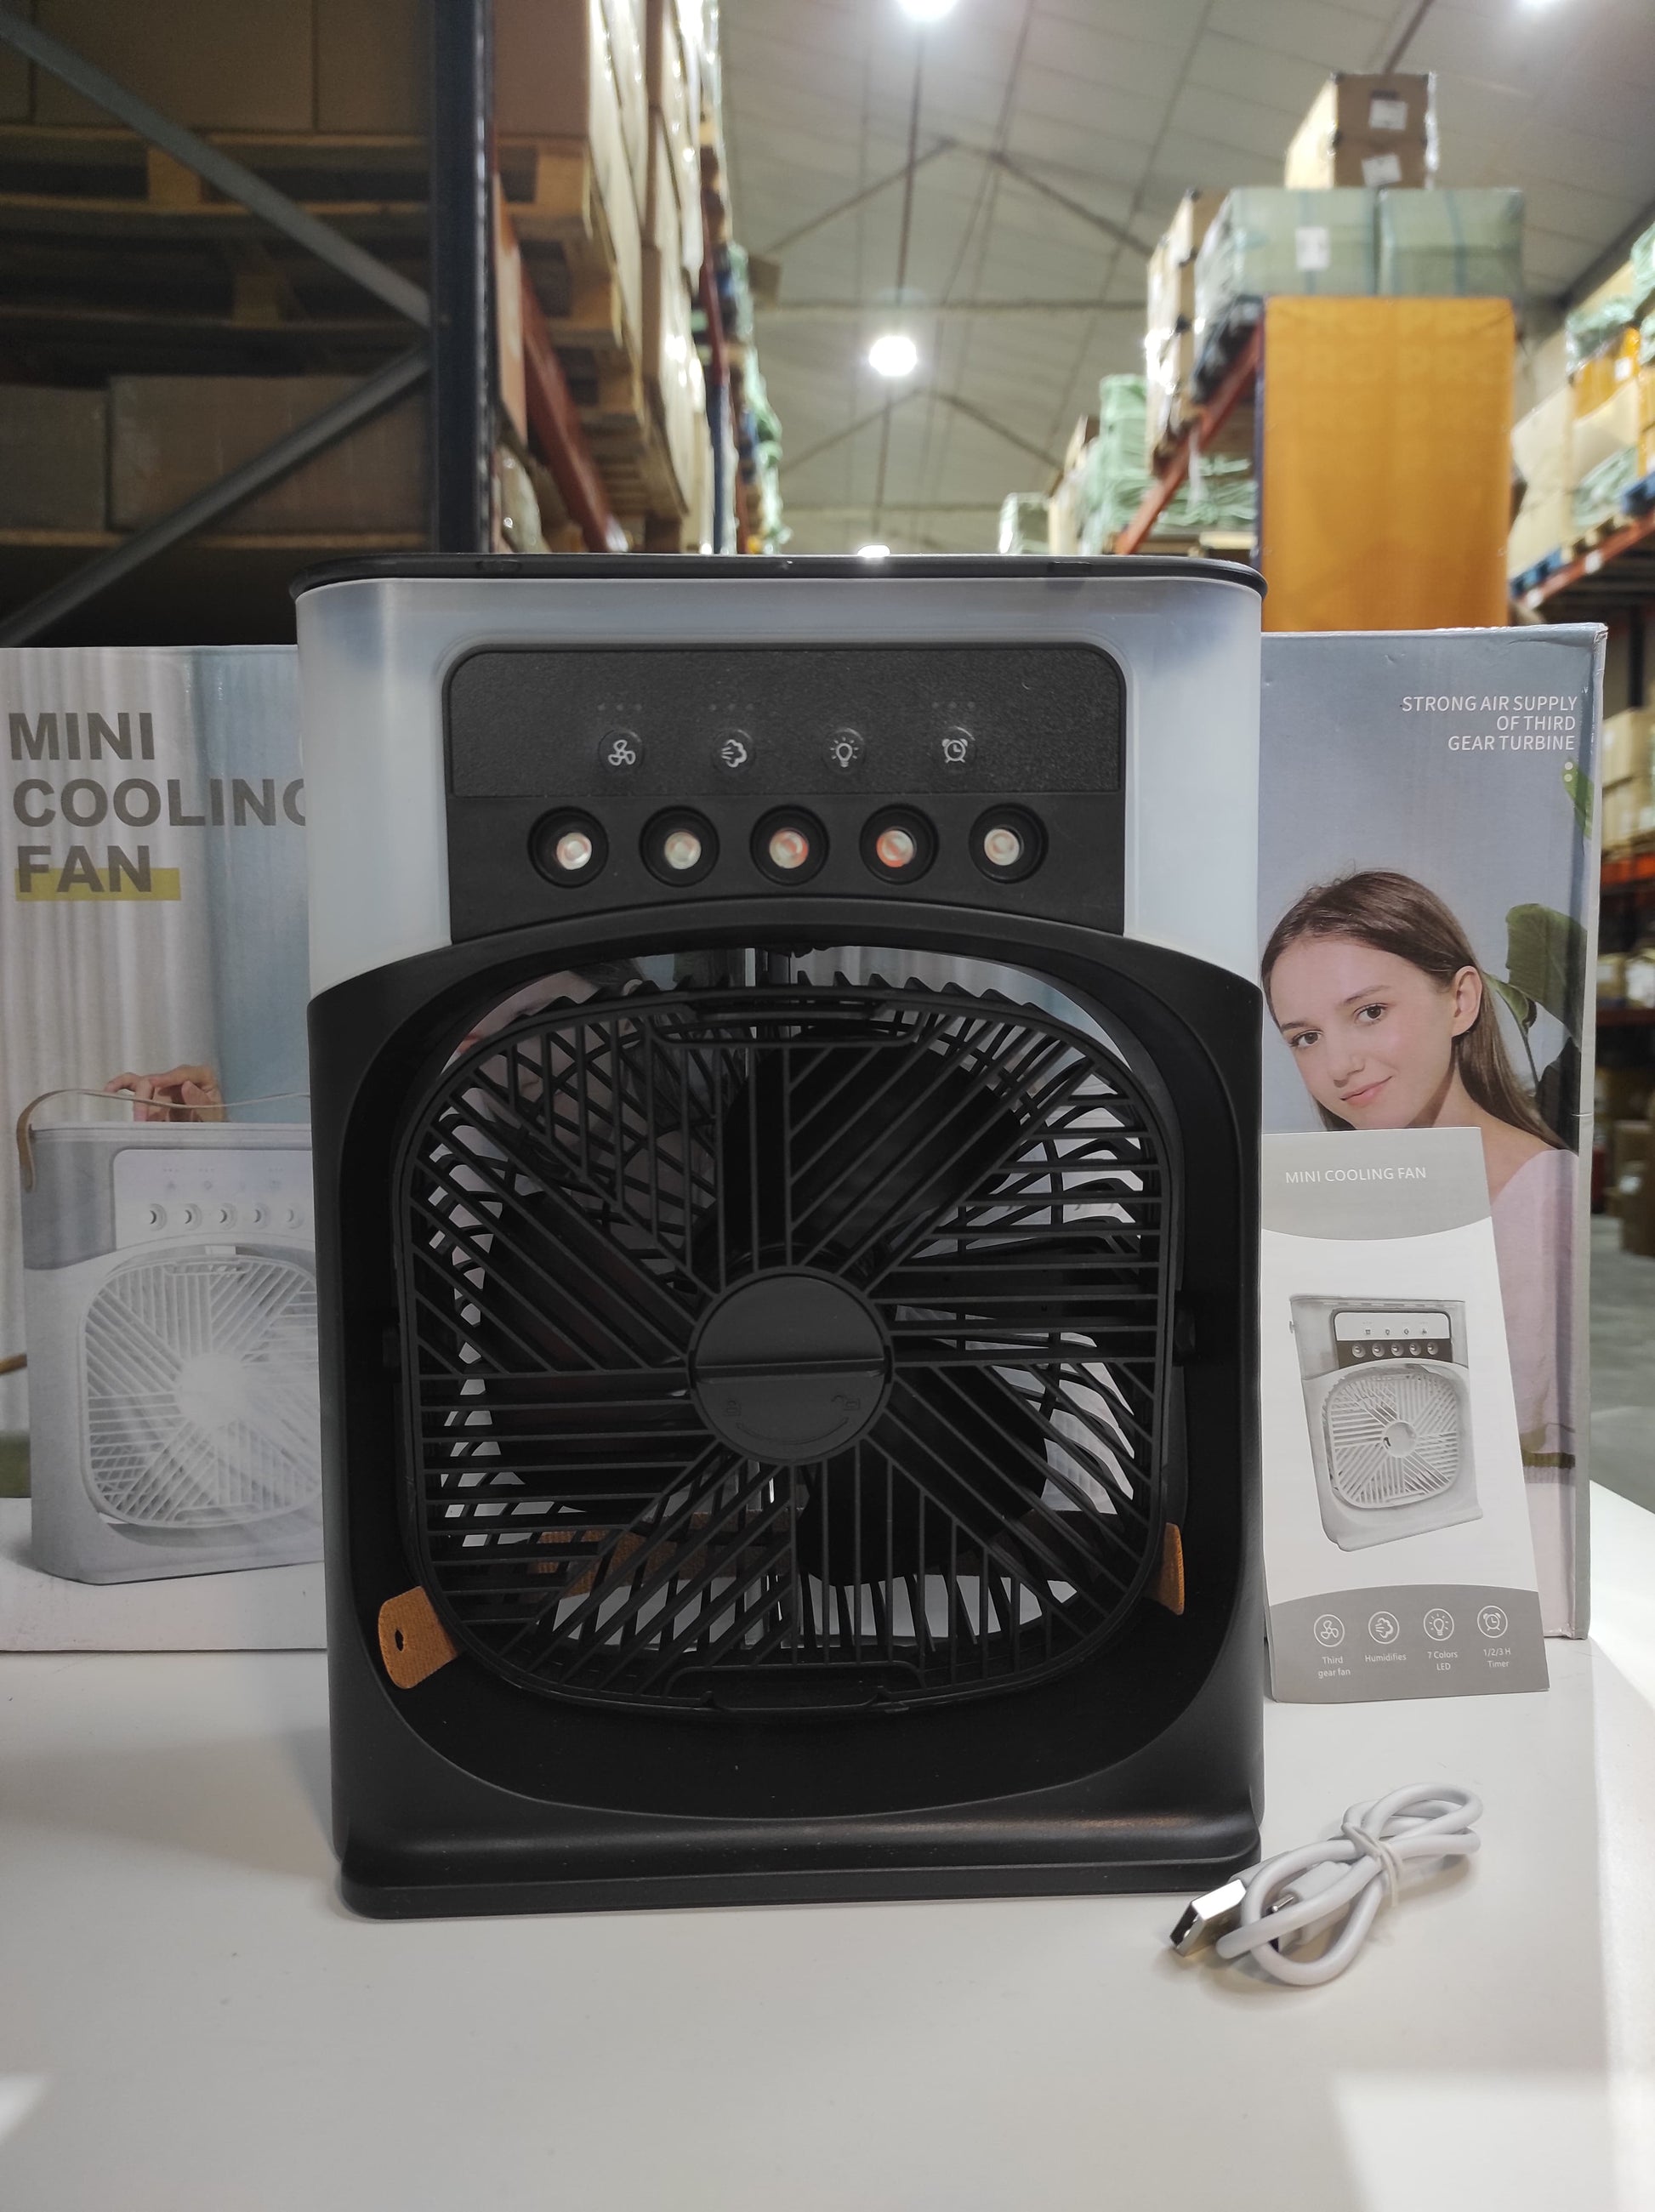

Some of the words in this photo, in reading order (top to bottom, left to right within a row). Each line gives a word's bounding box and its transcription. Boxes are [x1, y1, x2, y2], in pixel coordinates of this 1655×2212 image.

[1402, 695, 1477, 713] STRONG
[1480, 695, 1510, 712] AIR
[1512, 695, 1578, 712] SUPPLY
[1496, 715, 1521, 731] OF
[1523, 715, 1576, 731] THIRD
[9, 712, 155, 761] MINI
[1447, 736, 1496, 751] GEAR
[1498, 735, 1576, 751] TURBINE
[17, 844, 152, 894] FAN
[1285, 1170, 1321, 1184] MINI
[1324, 1168, 1395, 1182] COOLING
[1397, 1166, 1427, 1180] FAN
[1364, 1652, 1408, 1663] Humidifies
[1426, 1651, 1432, 1659] 7
[1433, 1650, 1459, 1659] Colors
[1504, 1647, 1511, 1656] H
[1322, 1655, 1344, 1664] Third
[1436, 1662, 1451, 1671] LED
[1317, 1669, 1336, 1680] gear
[1337, 1667, 1351, 1677] fan
